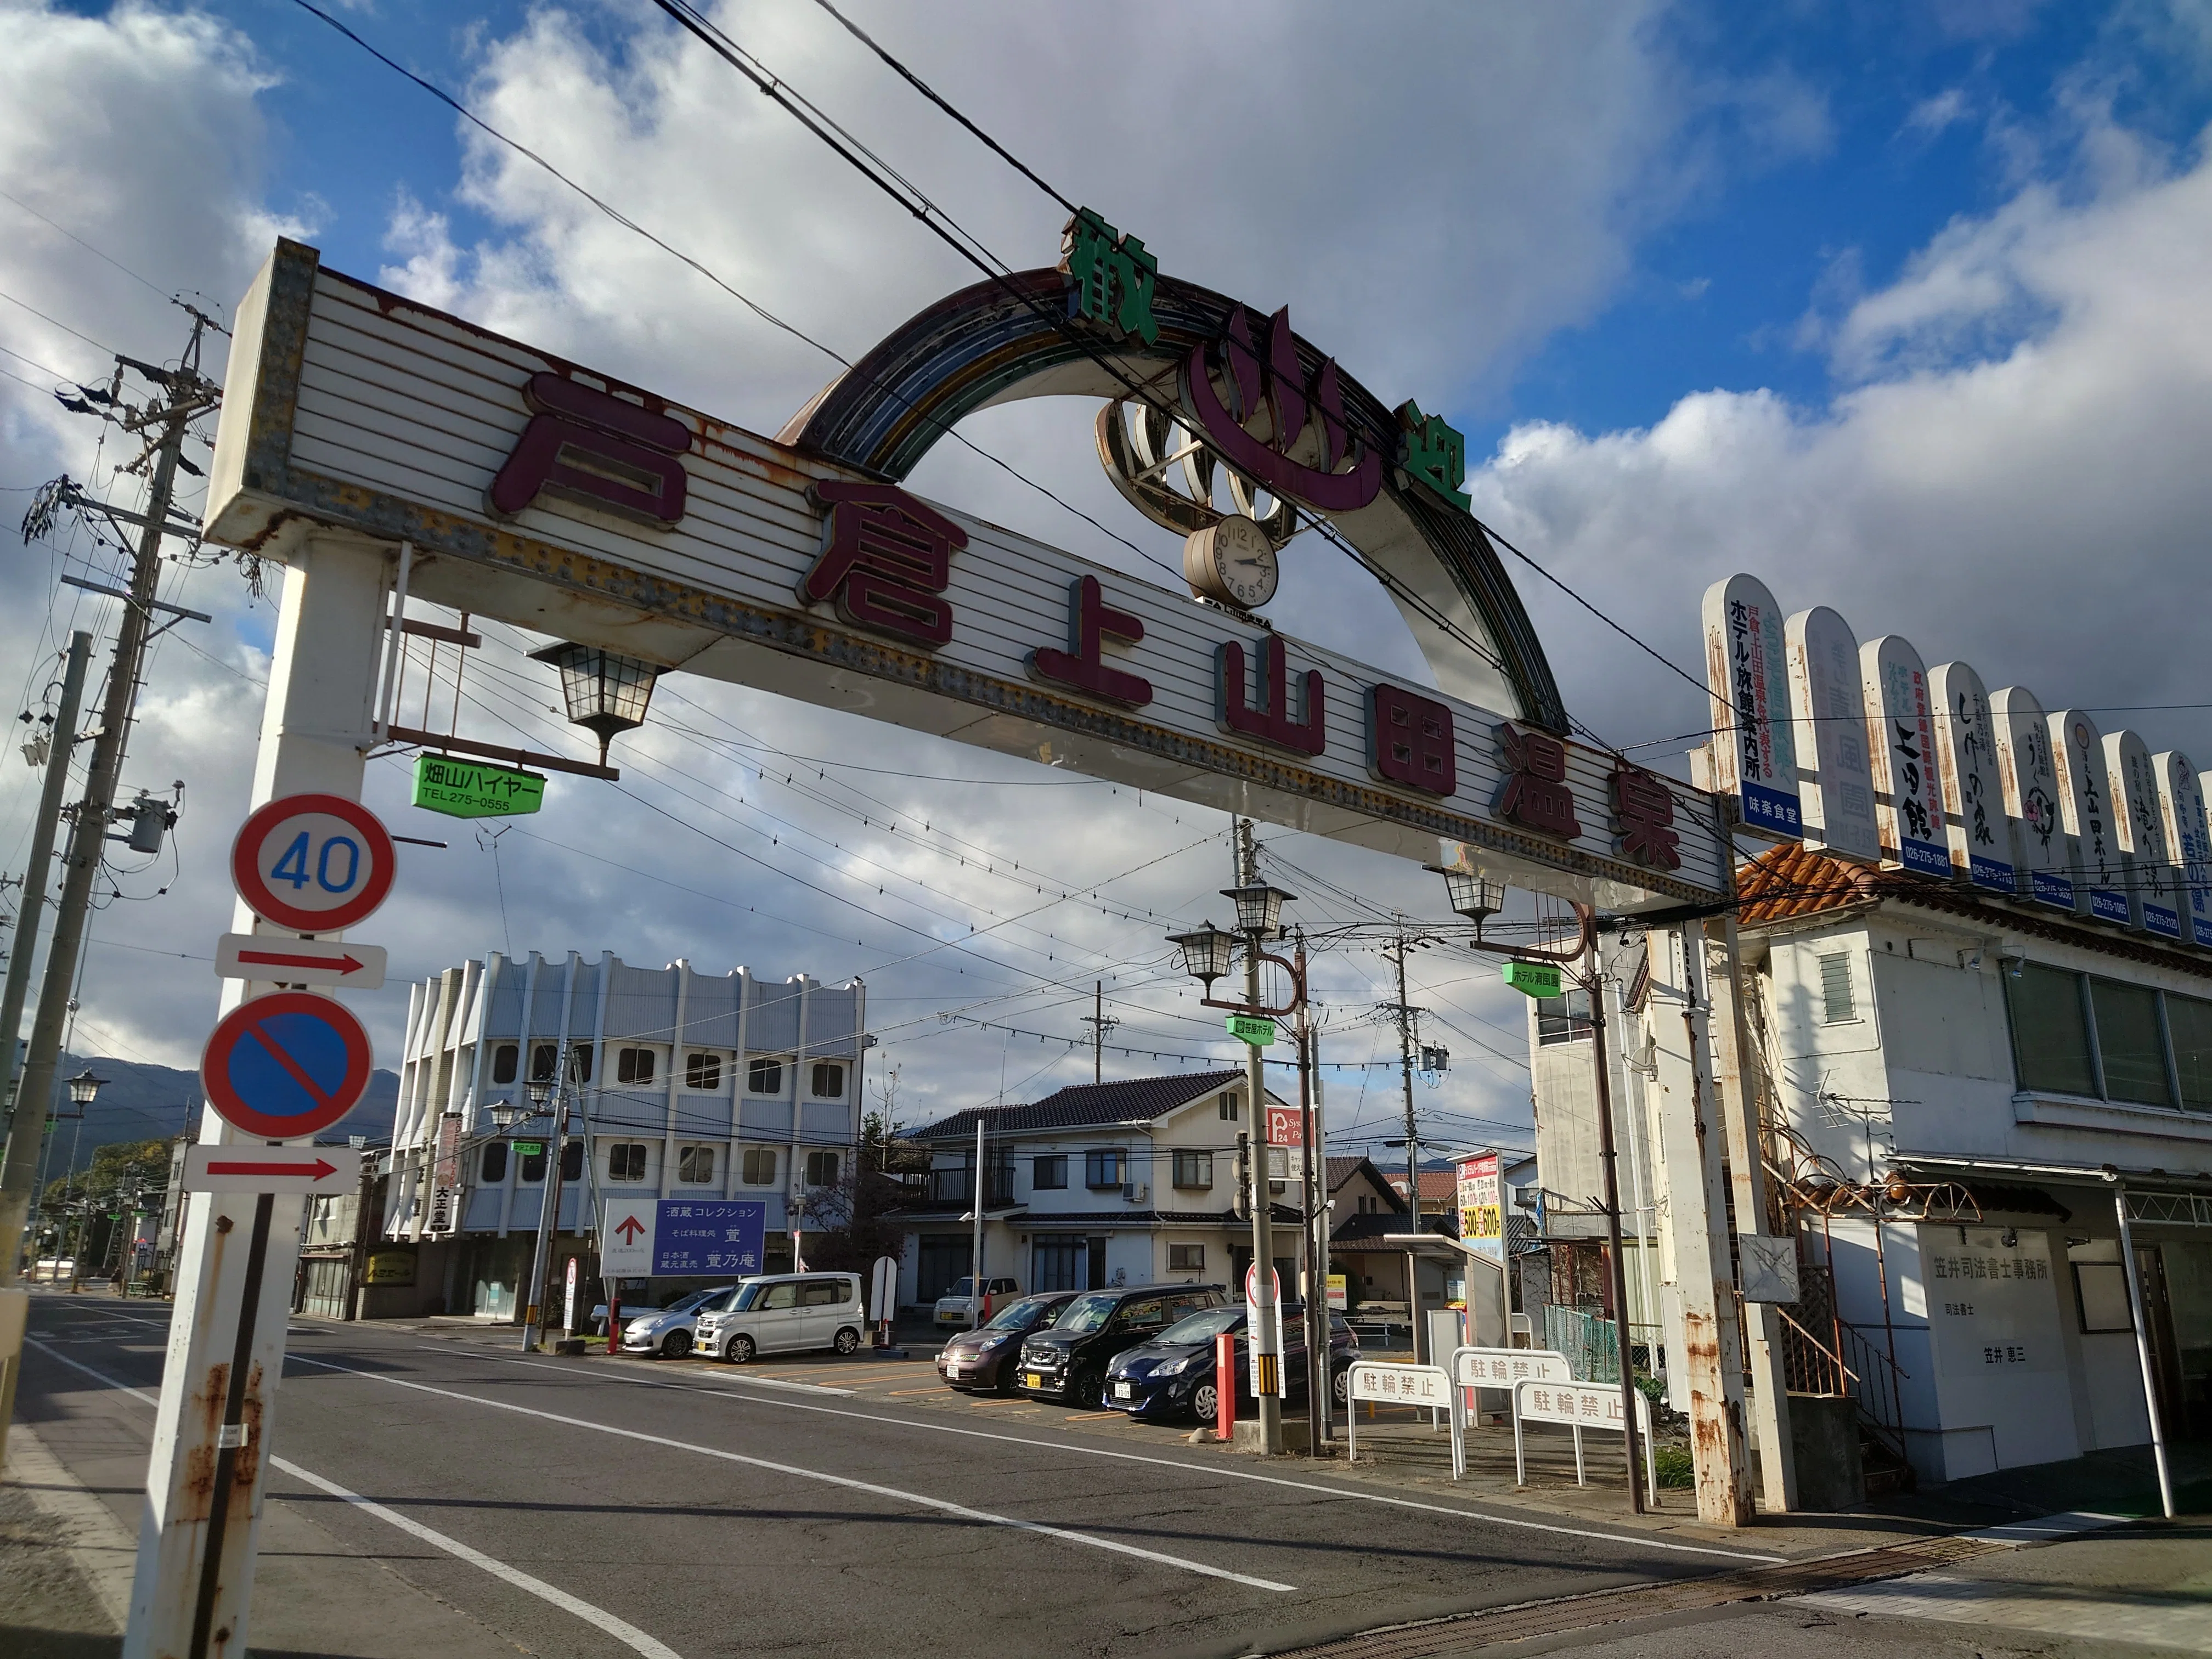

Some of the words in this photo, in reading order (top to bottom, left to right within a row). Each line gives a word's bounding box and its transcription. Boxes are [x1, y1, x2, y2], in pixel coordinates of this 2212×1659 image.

[1237, 527, 1248, 542] 12
[1215, 547, 1223, 560] 9
[1257, 549, 1264, 562] 2
[1219, 562, 1227, 575] 8
[1227, 577, 1235, 590] 7
[1237, 584, 1245, 597] 6
[1248, 585, 1256, 598] 5
[1256, 578, 1264, 591] 4
[482, 370, 1684, 872] 戸倉上山田温泉
[424, 763, 540, 798] 畑山ハイヤー
[1748, 795, 1798, 824] 味楽食堂
[270, 831, 360, 894] 40
[1905, 845, 1949, 870] 026-275-1881
[2091, 895, 2128, 915] 026-275-1005
[2145, 910, 2178, 930] 026-275-2120
[1514, 970, 1559, 988] ホテル清風園
[1245, 1023, 1273, 1036] 笹屋ホテル
[1278, 1135, 1288, 1143] 24
[432, 1187, 449, 1223] 大正堂
[671, 1229, 716, 1238] そば料理処
[662, 1251, 690, 1260] 日本酒
[660, 1260, 698, 1269] 蔵元直売
[1934, 1256, 2048, 1280] 笠井司法書士事務所
[1944, 1302, 1974, 1317] 司法書士
[1984, 1346, 2004, 1364] 笠井
[2006, 1346, 2025, 1363] 恵三
[1470, 1358, 1551, 1380] 駐輪禁止
[1363, 1372, 1435, 1398] 駐輪禁止
[1533, 1390, 1624, 1421] 駐輪禁止
